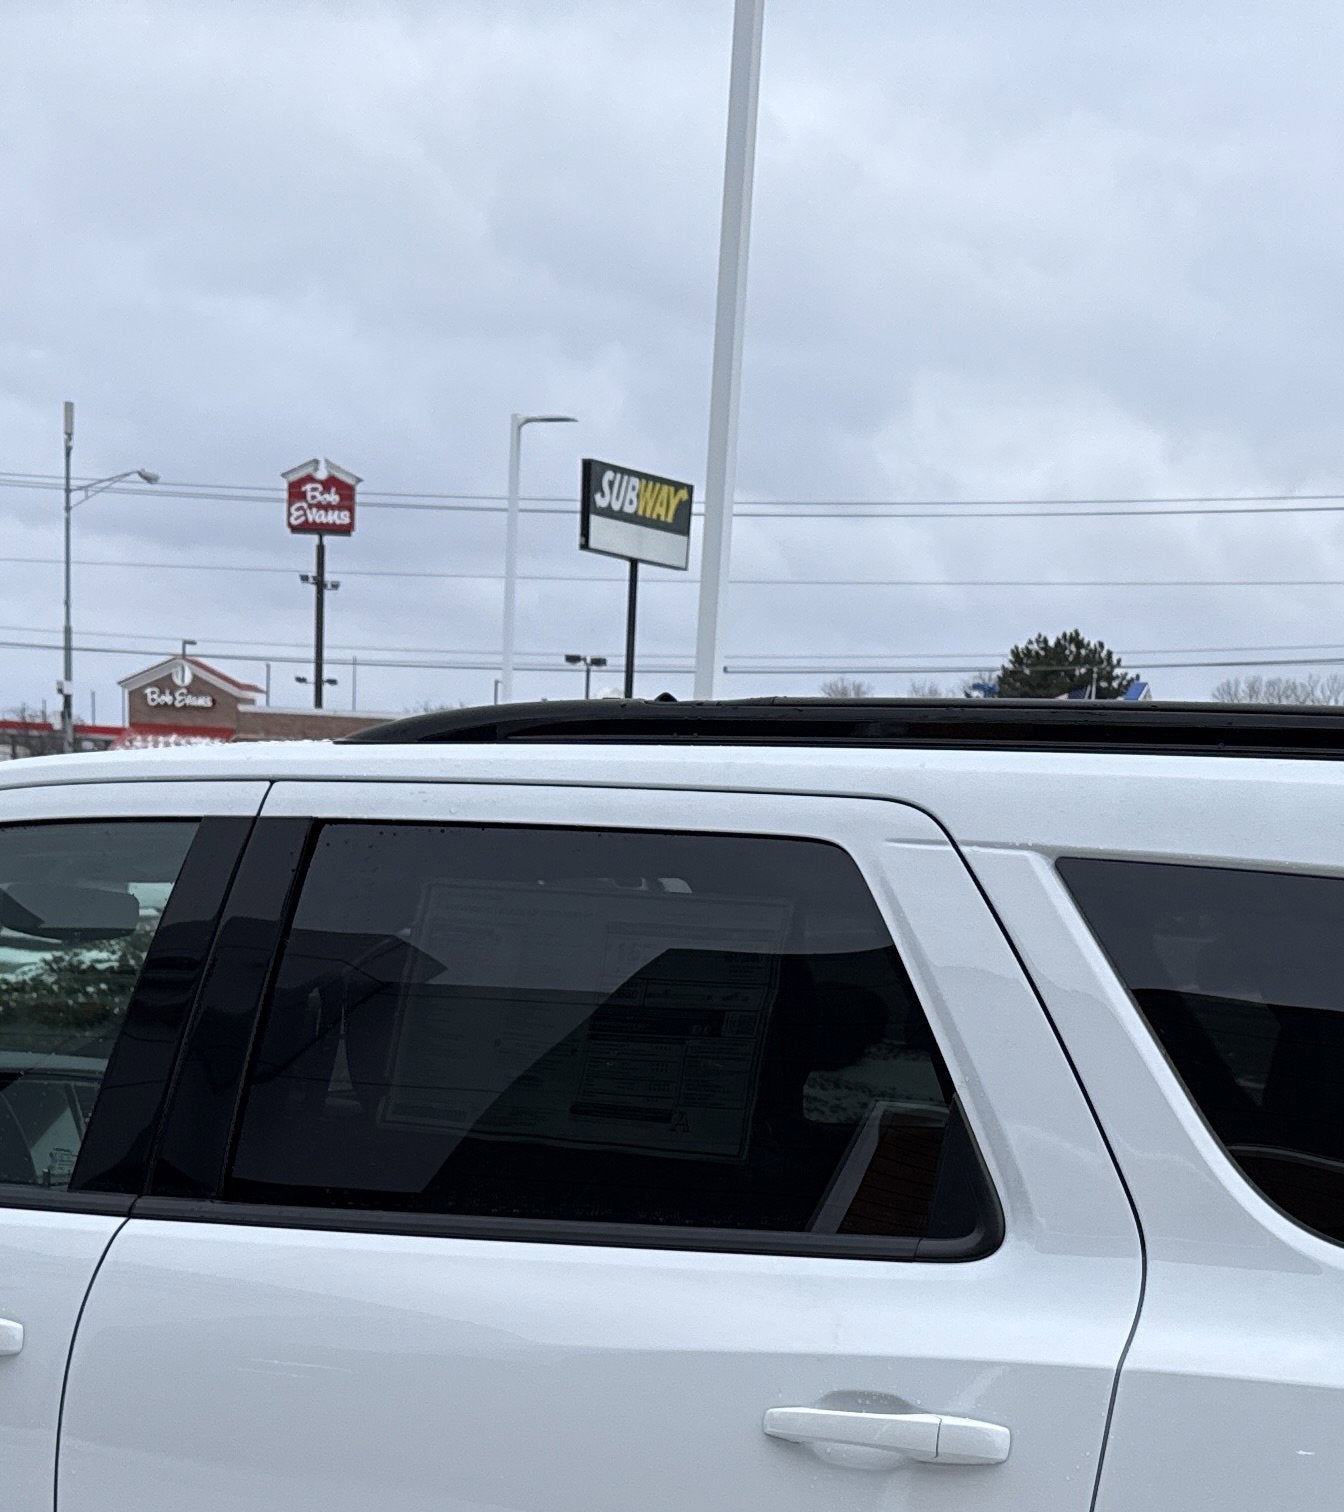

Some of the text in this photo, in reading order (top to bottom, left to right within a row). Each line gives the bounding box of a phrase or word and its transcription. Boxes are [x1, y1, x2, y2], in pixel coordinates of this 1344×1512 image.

[301, 483, 340, 505] Bob
[594, 470, 689, 523] SUBWAY
[289, 502, 351, 526] Evans
[144, 687, 213, 708] Bob Evans
